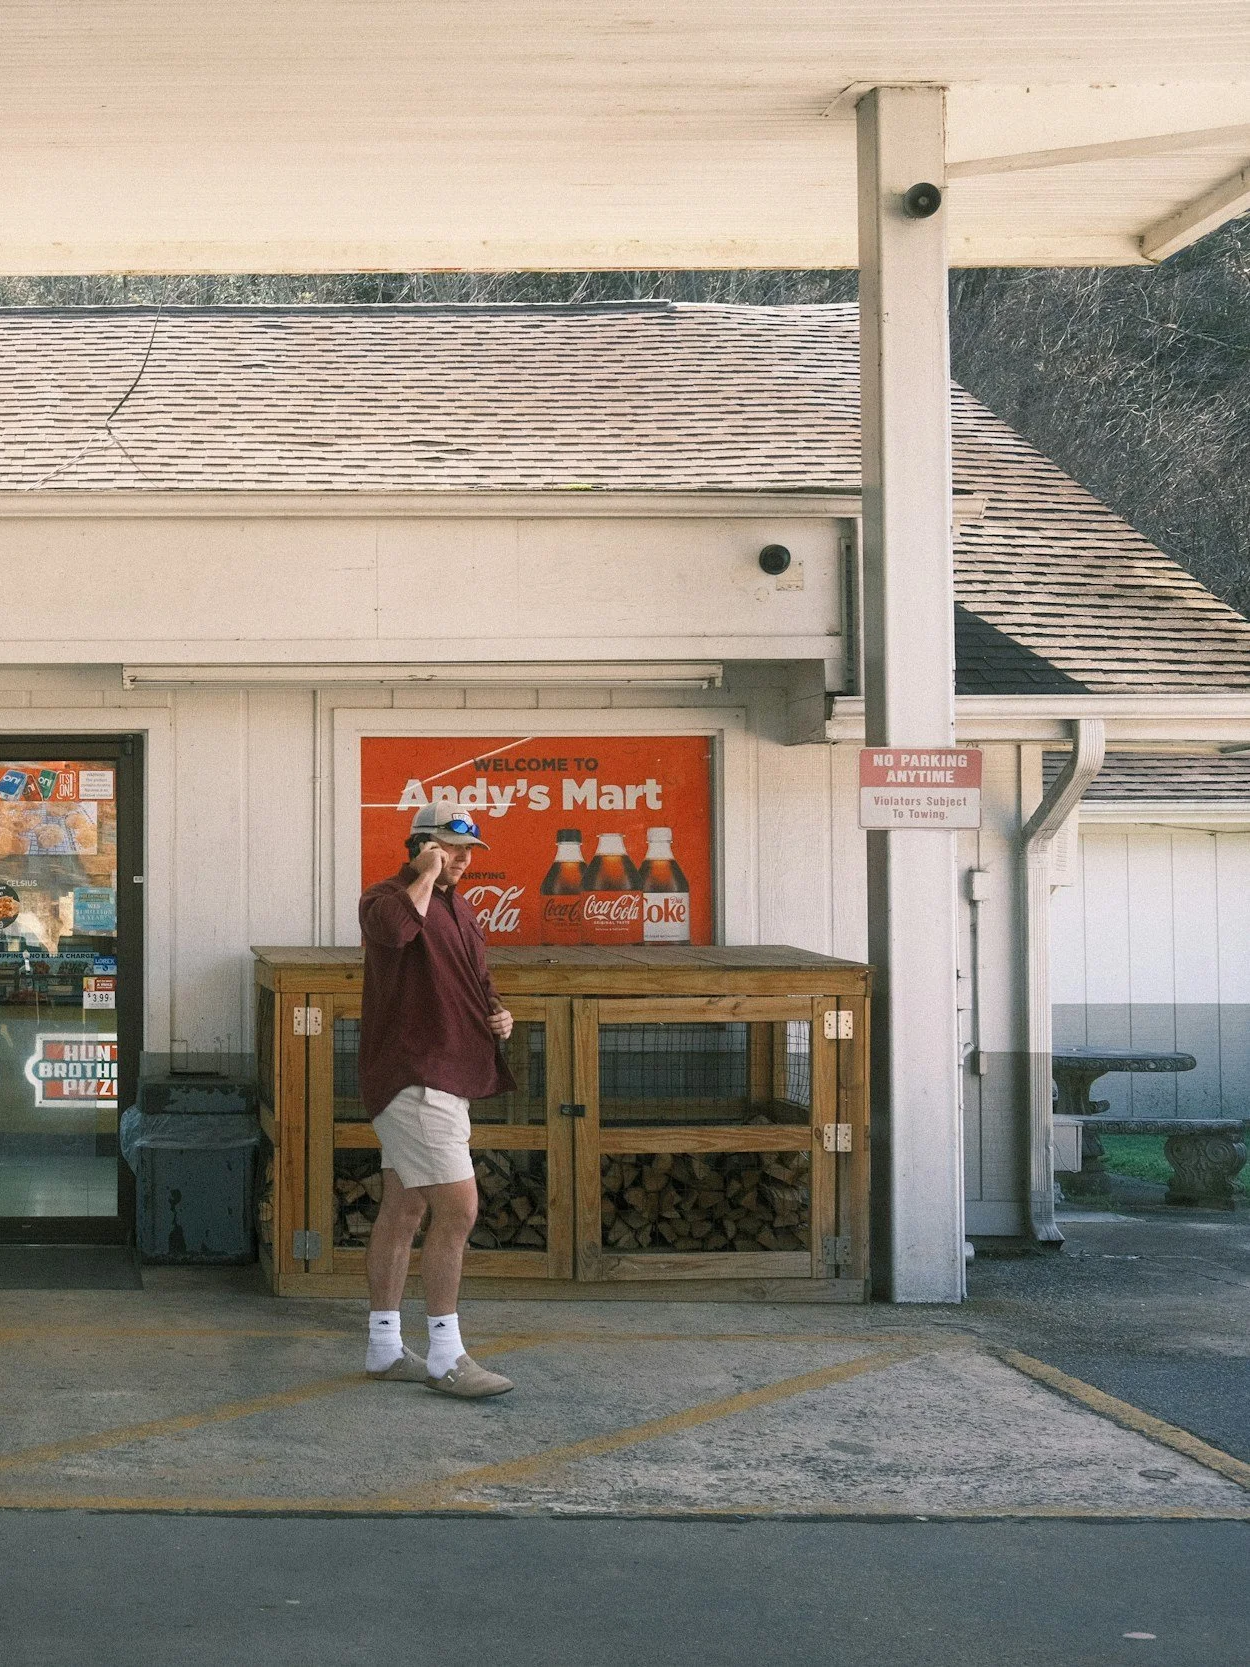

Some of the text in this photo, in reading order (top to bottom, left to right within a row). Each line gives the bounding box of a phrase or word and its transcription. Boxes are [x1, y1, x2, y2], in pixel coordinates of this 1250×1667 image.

[473, 757, 599, 772] WELCOME TO
[872, 754, 968, 768] NO PARKING
[885, 770, 955, 783] ANYTIME
[397, 777, 663, 818] Andy's Mart
[873, 796, 967, 808] Violators Subject
[892, 809, 948, 820] To Towing.
[583, 894, 641, 921] Coca-Cola
[38, 1062, 118, 1078] BROTH
[62, 1079, 118, 1096] PIZZ
